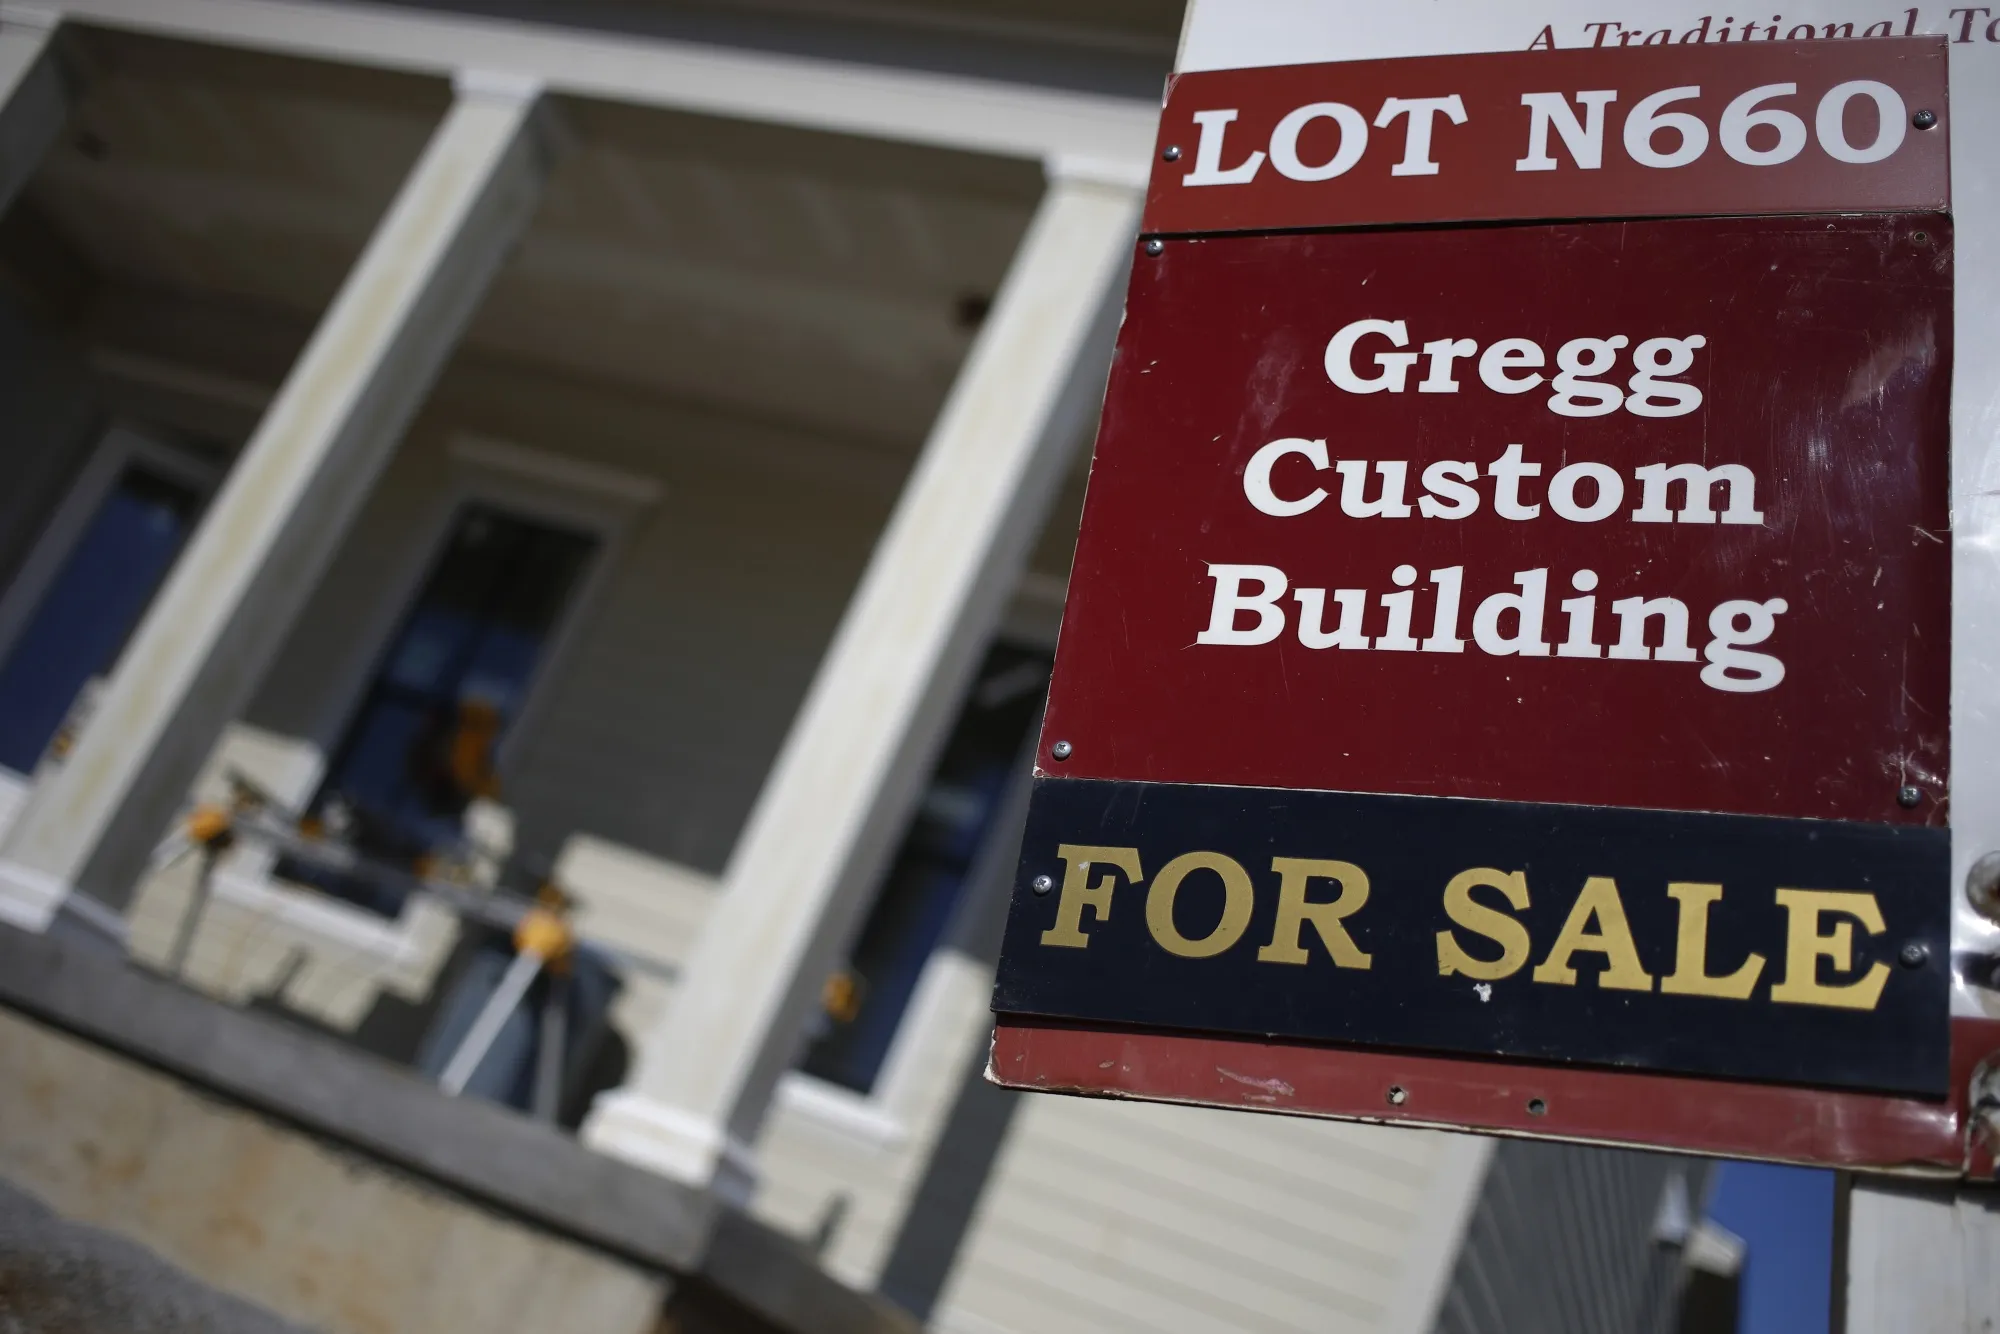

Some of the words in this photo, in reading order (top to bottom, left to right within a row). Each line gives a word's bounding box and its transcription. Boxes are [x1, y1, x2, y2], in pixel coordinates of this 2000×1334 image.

[1527, 23, 1556, 50] A
[1182, 93, 1469, 187] LOT
[1515, 79, 1907, 172] N660
[1324, 318, 1707, 418] Gregg
[1243, 437, 1766, 527] Custom
[1193, 563, 1789, 693] Building
[1040, 843, 1372, 970] FOR
[1435, 867, 1892, 1011] SALE
